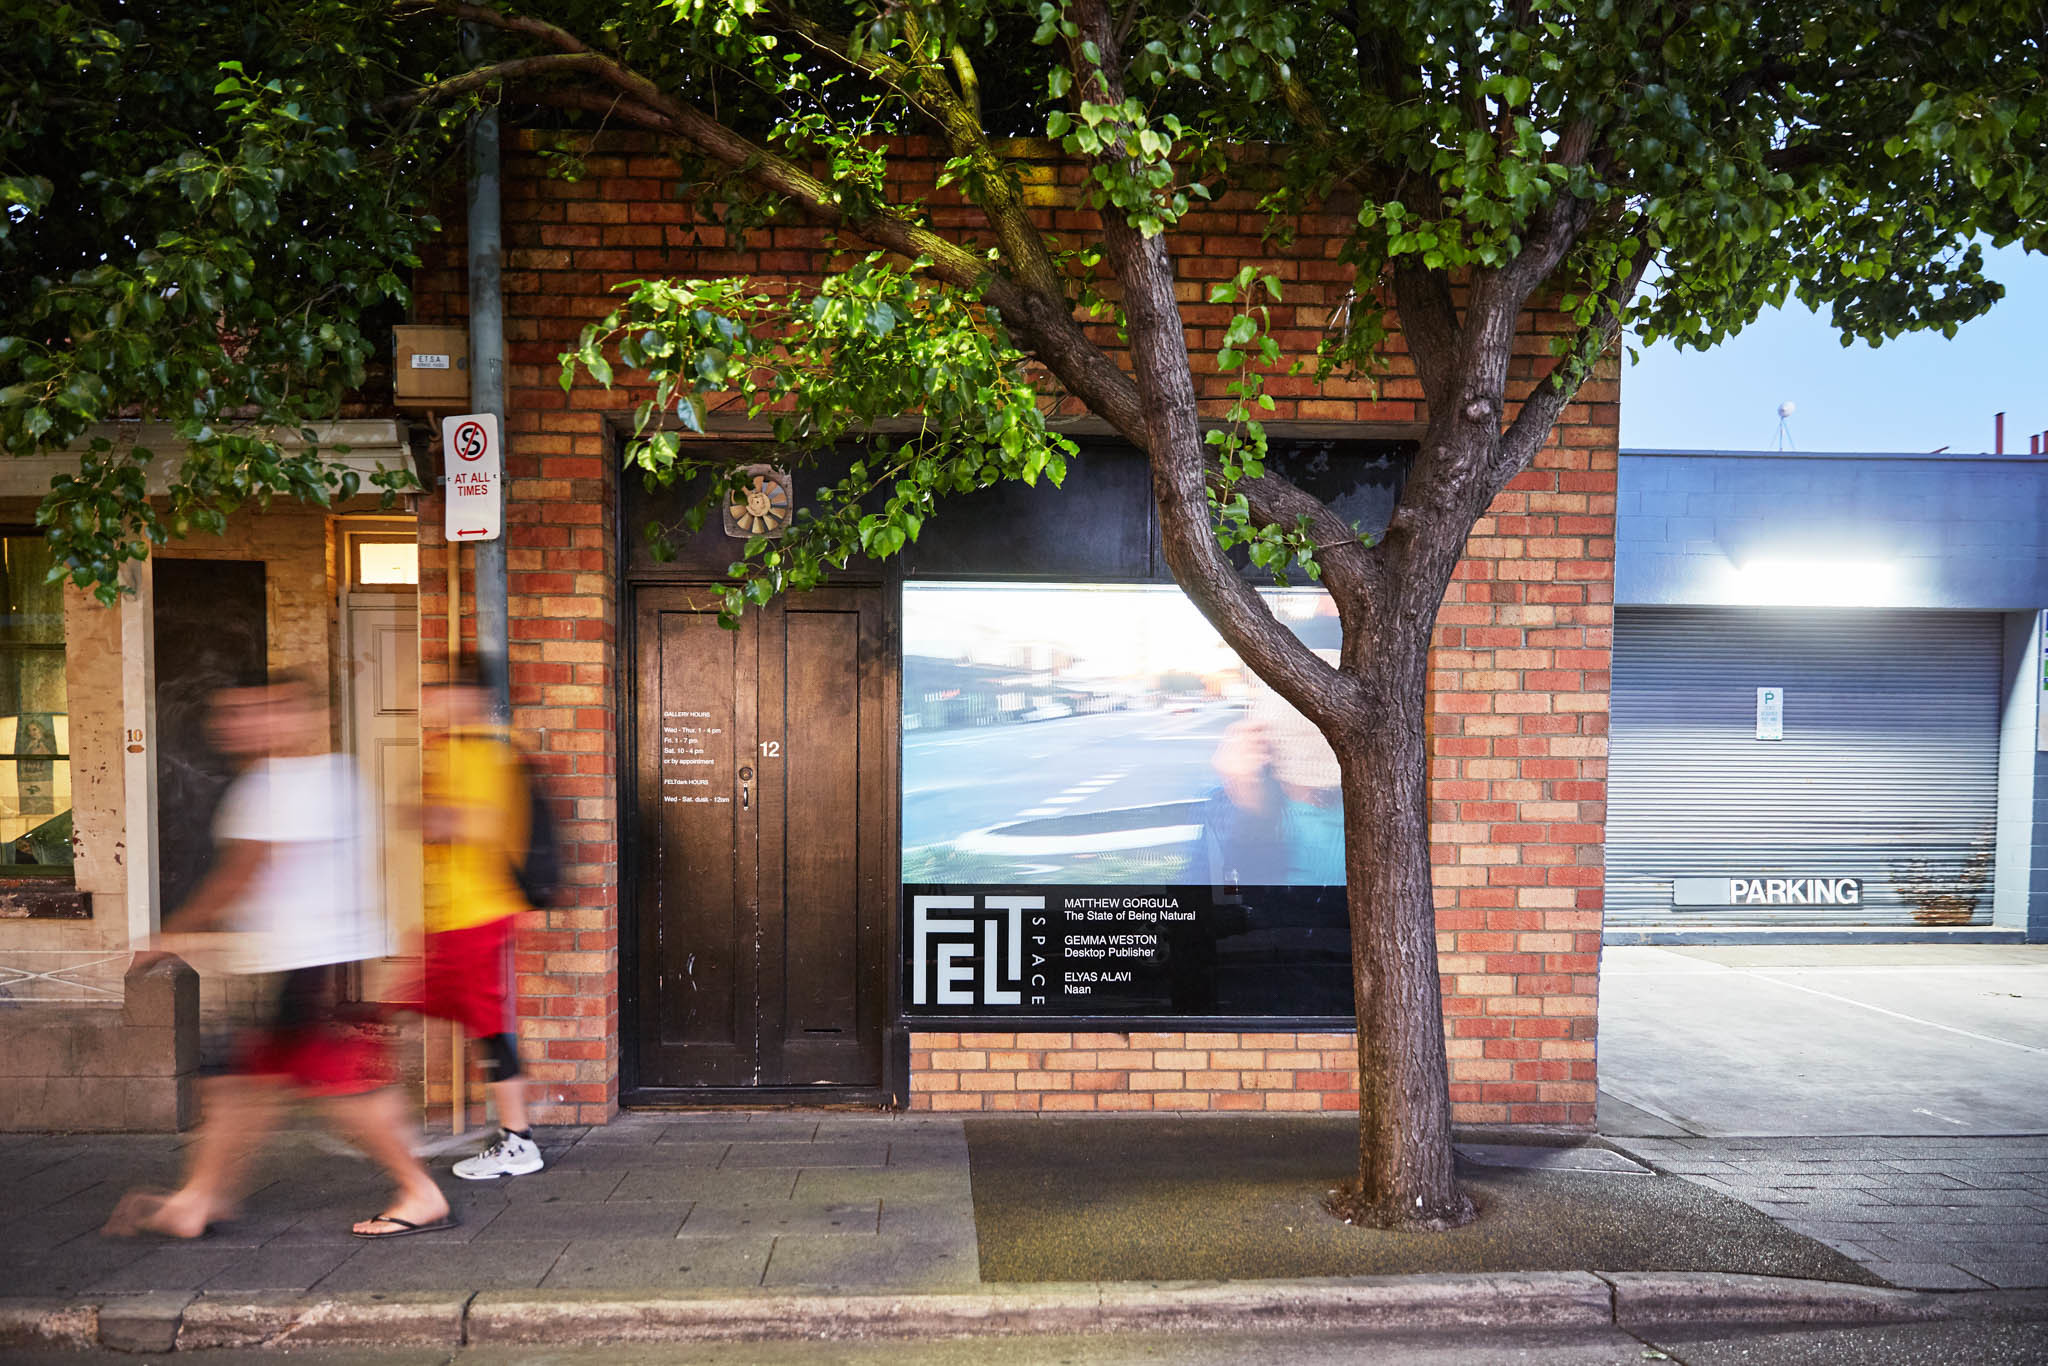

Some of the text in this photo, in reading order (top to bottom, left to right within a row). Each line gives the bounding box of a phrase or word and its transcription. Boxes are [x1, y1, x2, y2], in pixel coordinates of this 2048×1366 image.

[454, 472, 491, 484] AT ALL
[457, 484, 488, 496] TIMES
[127, 729, 143, 742] 10
[759, 741, 780, 757] 12
[1730, 878, 1859, 905] PARKING
[1064, 898, 1179, 908] MATTHEW GORGULA
[1064, 910, 1196, 923] The State of Being Natural
[1064, 934, 1157, 945] GEMMA WESTON
[913, 895, 1046, 1005] FELT
[1064, 947, 1155, 959] Desktop Publisher
[1032, 917, 1046, 1005] SPACE
[1064, 971, 1132, 982] ELYAS ALAVI
[1064, 984, 1091, 994] Naan
